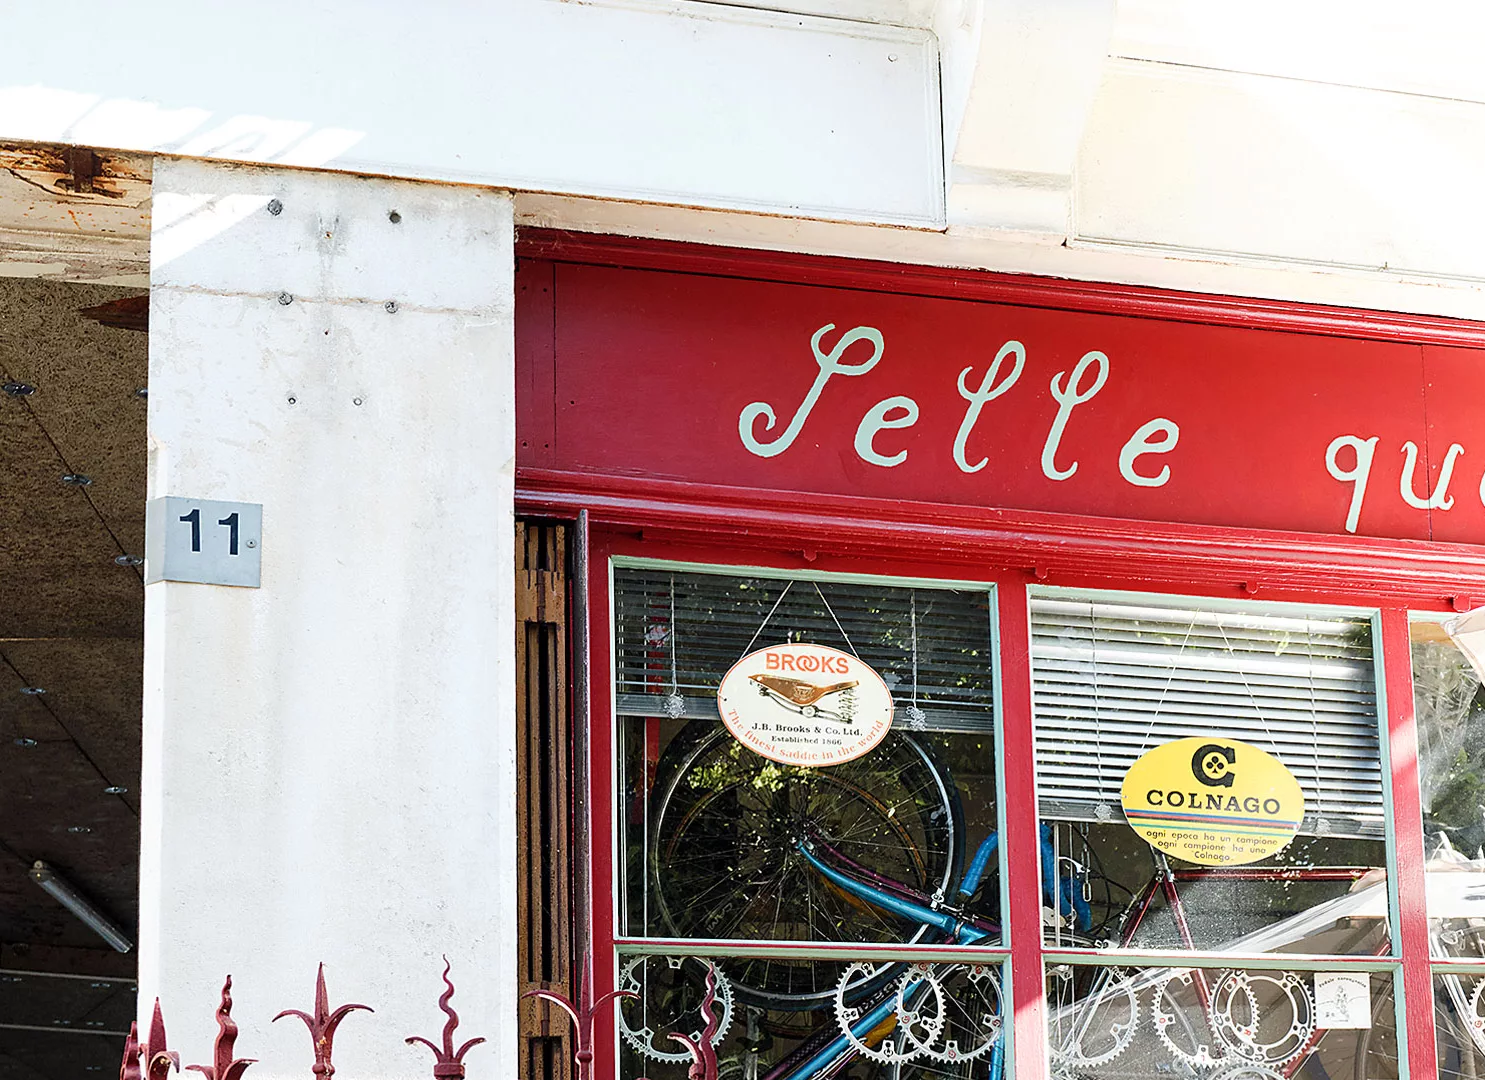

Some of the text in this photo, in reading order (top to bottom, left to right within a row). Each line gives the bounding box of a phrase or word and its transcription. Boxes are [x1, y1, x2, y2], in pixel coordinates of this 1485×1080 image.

[738, 323, 1180, 488] Selle
[179, 508, 241, 558] 11
[765, 652, 849, 675] BROOKS
[728, 709, 744, 730] The
[744, 730, 776, 753] finest
[821, 752, 834, 760] in
[837, 746, 856, 758] the
[857, 720, 885, 749] world
[751, 722, 863, 737] J.B. Brooks & Co. Ltd.
[771, 735, 819, 745] Established
[1146, 789, 1281, 815] COLNAGO
[1146, 830, 1278, 846] ogni epoca ha un campione
[1157, 840, 1266, 854] ogni campione ha una
